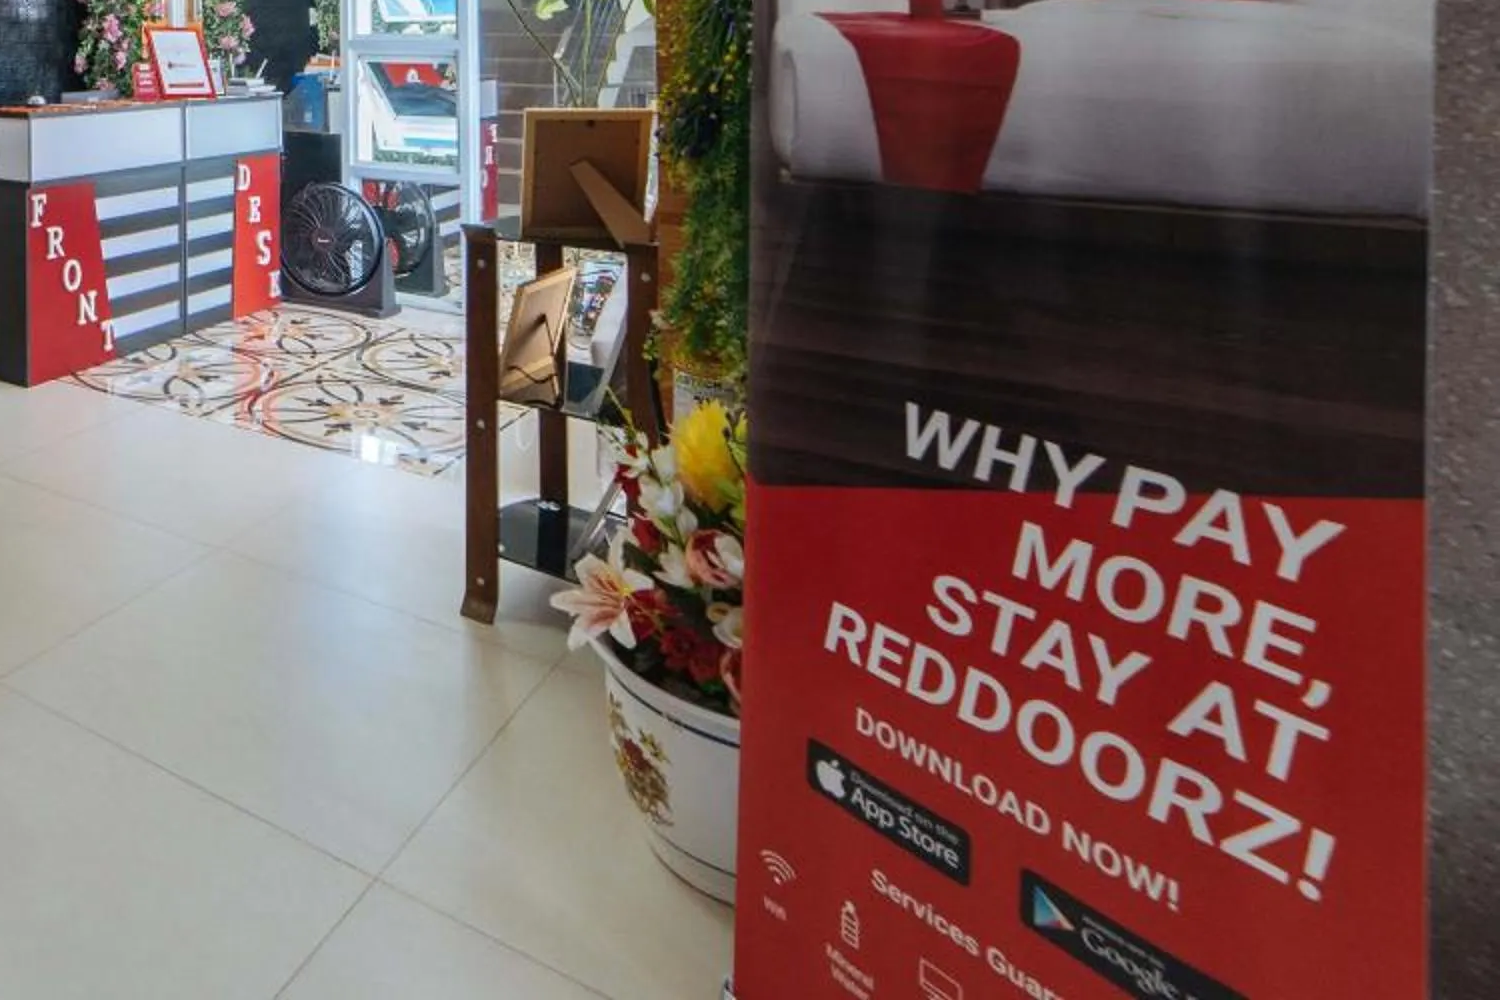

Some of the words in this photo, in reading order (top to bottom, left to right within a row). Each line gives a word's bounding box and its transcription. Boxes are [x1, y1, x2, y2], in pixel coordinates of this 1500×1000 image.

[30, 193, 117, 352] FRONT
[905, 401, 1106, 508] WHY
[1111, 465, 1347, 582] PAY
[925, 575, 1153, 706] STAY
[1166, 680, 1331, 782] AT
[1011, 520, 1333, 709] MORE,
[823, 601, 1336, 902] REDDOORZ!
[851, 786, 895, 829] App
[898, 815, 960, 869] Store
[855, 707, 1051, 836] DOWNLOAD
[1061, 821, 1180, 912] NOW!
[870, 868, 980, 956] Services
[1081, 927, 1183, 1000] Google
